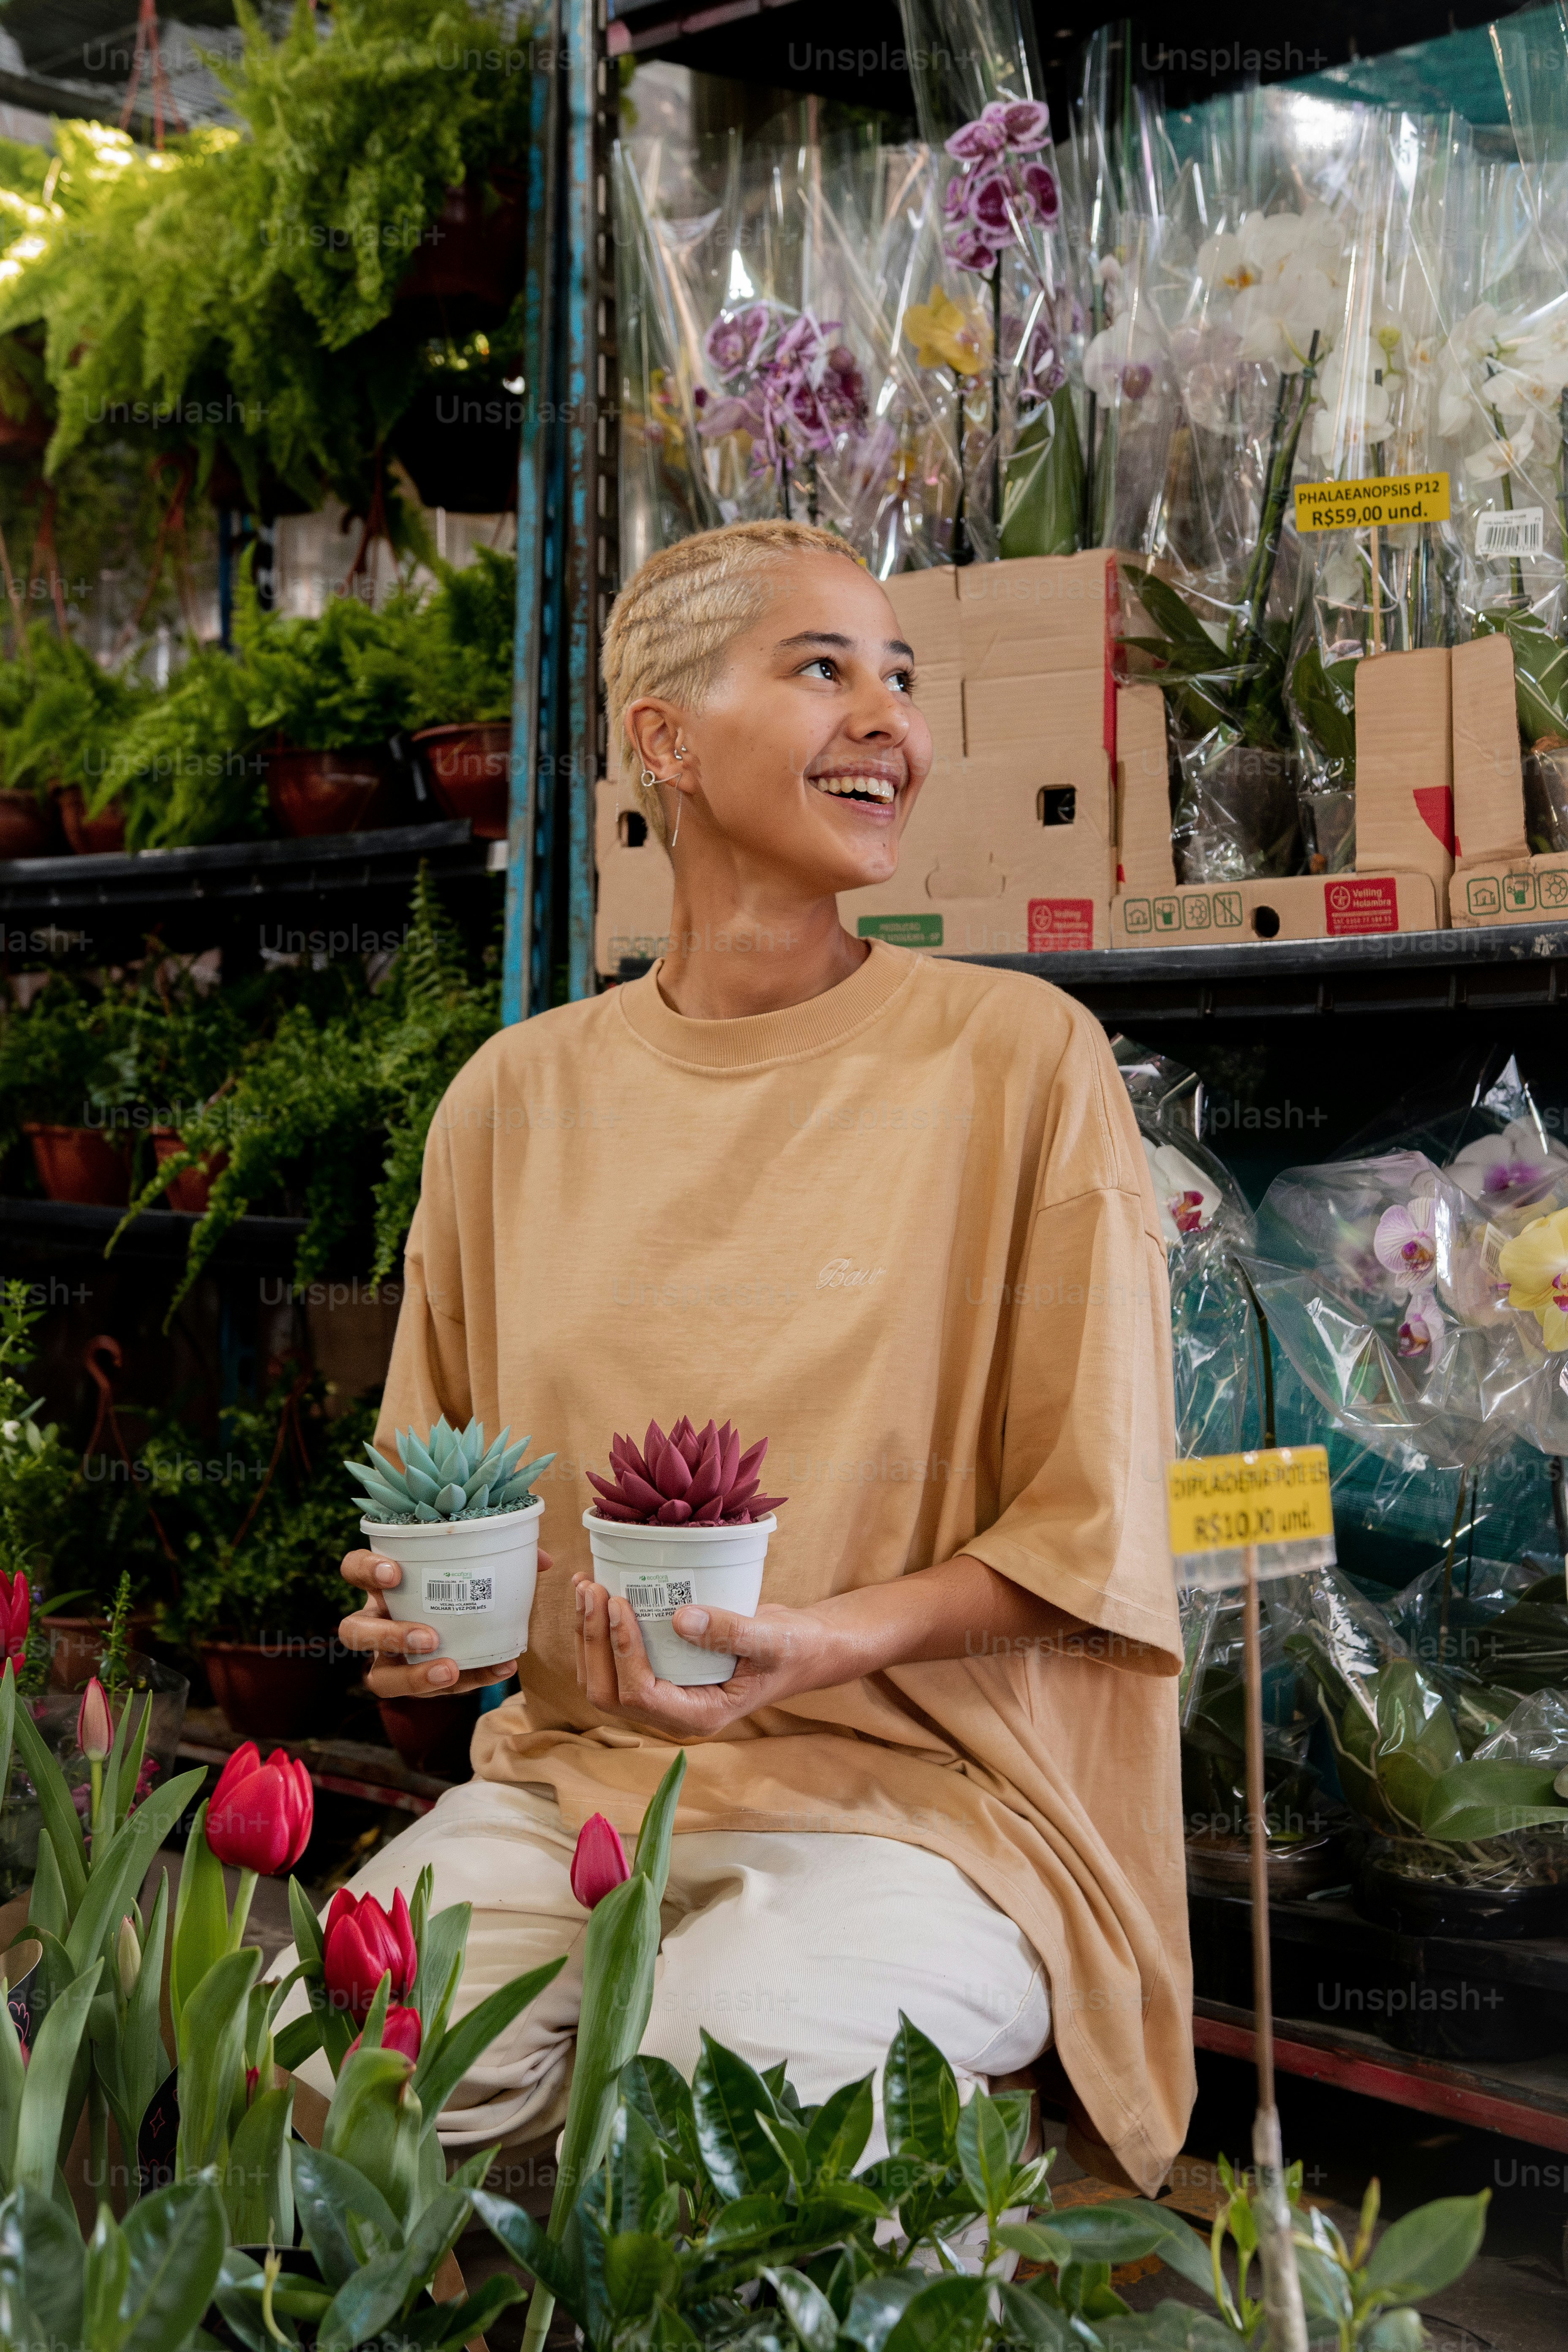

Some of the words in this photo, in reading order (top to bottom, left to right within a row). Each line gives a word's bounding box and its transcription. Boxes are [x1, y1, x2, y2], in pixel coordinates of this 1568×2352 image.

[1298, 484, 1411, 504] PHALAEANOPSIS
[1415, 481, 1440, 495] P12
[1312, 506, 1383, 527] R$59,00
[1388, 501, 1428, 520] und.
[1353, 898, 1391, 908] Holambra
